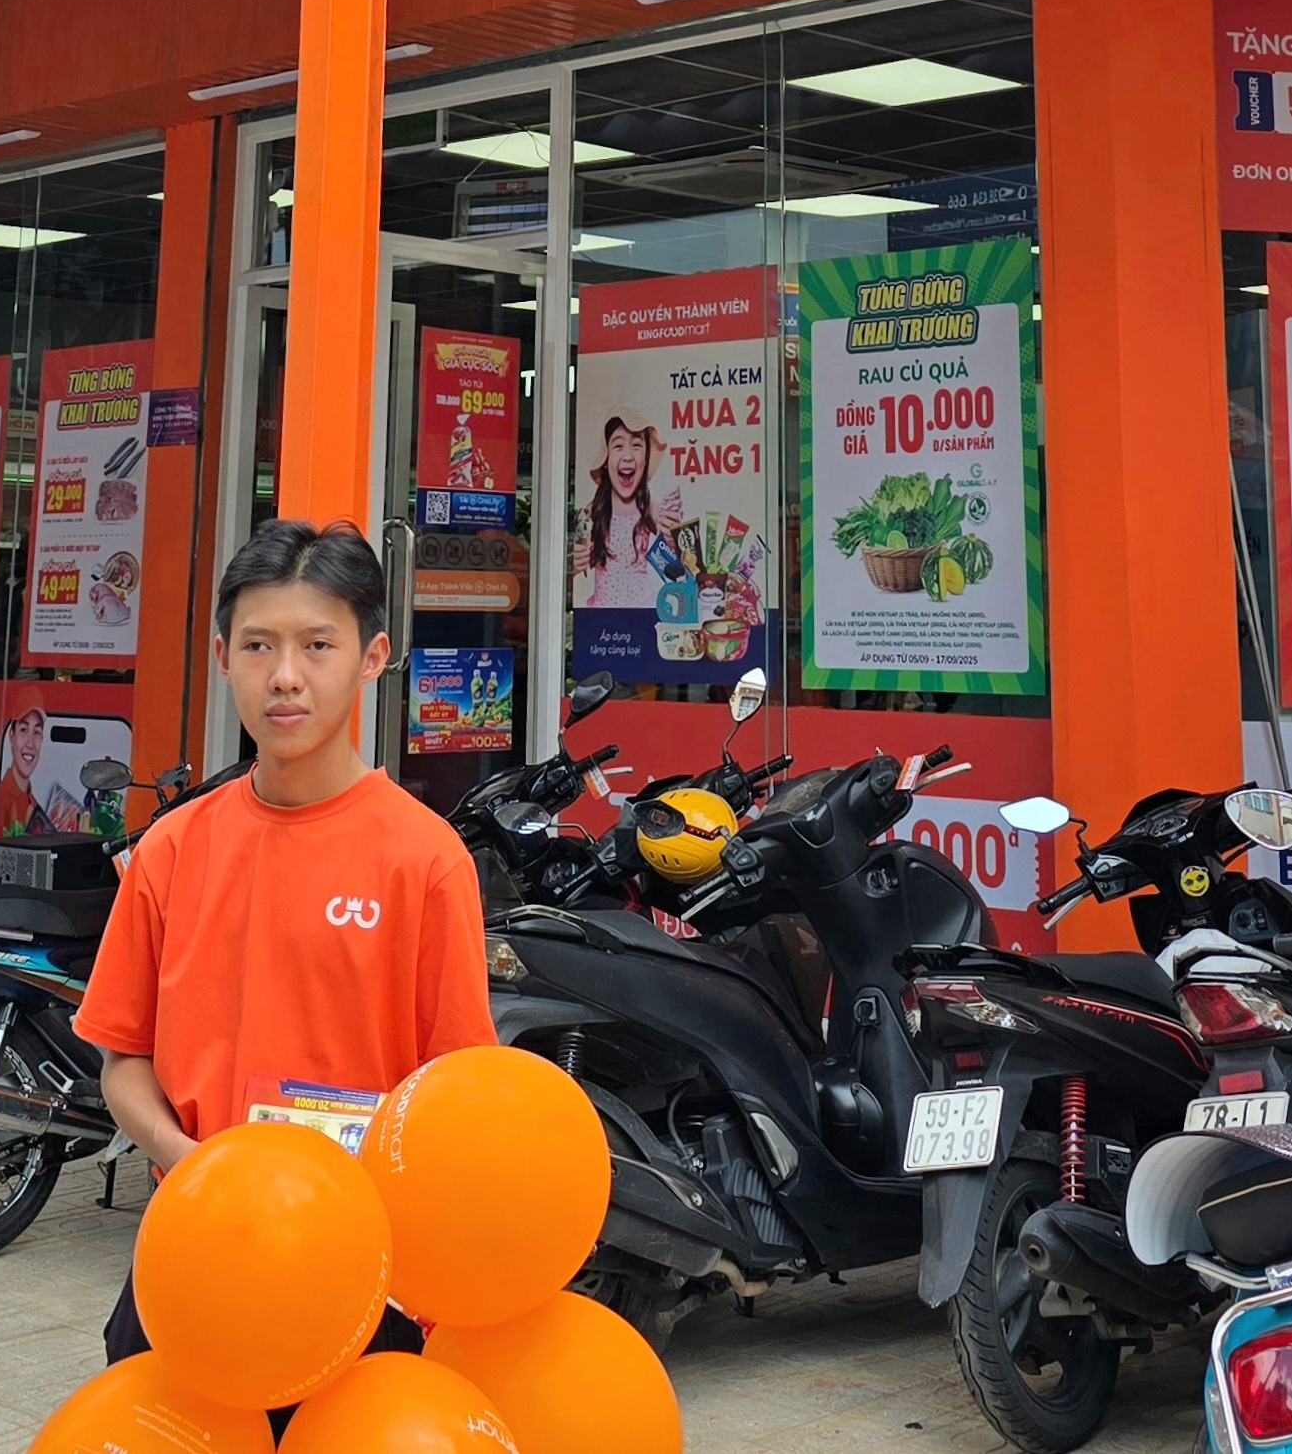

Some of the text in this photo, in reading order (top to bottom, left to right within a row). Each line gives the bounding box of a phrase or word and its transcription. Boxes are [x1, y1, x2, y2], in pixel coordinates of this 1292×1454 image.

[1248, 76, 1260, 126] VOUCHER
[1232, 163, 1272, 180] ĐƠN
[859, 276, 963, 312] TƯNG BỪNG
[602, 297, 749, 329] ĐẶC QUYỀN THÀNH VIÊN
[637, 322, 711, 341] KINGFOODmart
[851, 312, 974, 347] KHAI TRƯƠNG
[670, 364, 762, 390] TẤT CẢ KEM
[859, 356, 969, 385] RAU CỦ QUẢ
[60, 401, 89, 426] KHAI
[462, 389, 505, 414] 69.000
[671, 394, 761, 430] MUA 2
[836, 399, 875, 428] ĐỒNG
[879, 386, 994, 454] 10.000
[844, 430, 868, 455] GIÁ
[967, 431, 995, 450] PHẨM
[670, 438, 761, 484] TẶNG 1
[46, 484, 82, 511] 29.000
[40, 574, 77, 601] 49.000
[599, 628, 631, 643] Áp dụng
[873, 654, 895, 665] DỤNG
[897, 652, 907, 664] TỪ
[909, 655, 929, 664] 05/09
[936, 655, 978, 665] 17/09/2025
[925, 1094, 988, 1128] 59-F2
[912, 1128, 991, 1164] 073.98
